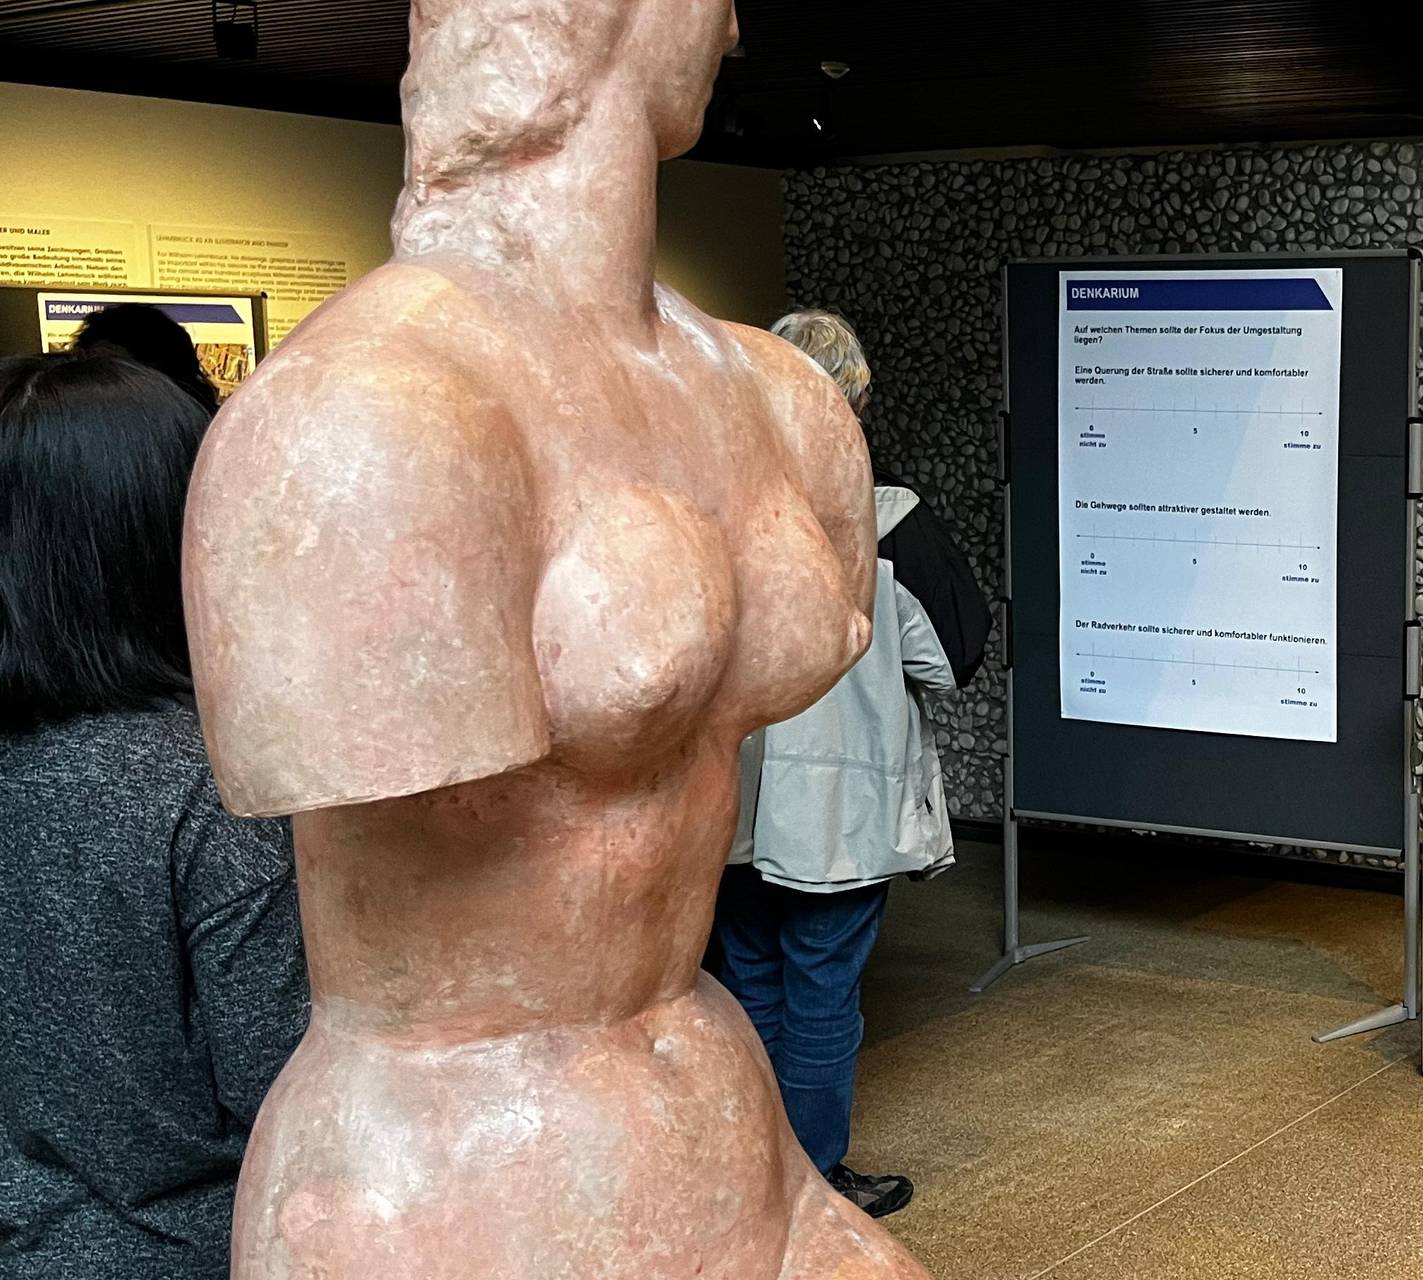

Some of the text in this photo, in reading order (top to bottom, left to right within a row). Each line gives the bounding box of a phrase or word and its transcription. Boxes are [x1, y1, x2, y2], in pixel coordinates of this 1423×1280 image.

[1071, 287, 1140, 299] DENKARIUM
[1074, 326, 1302, 336] Auf welchen Themen sollte der Fokus der Umgestaltung
[1074, 336, 1103, 345] liegen?
[1075, 366, 1309, 377] Eine Querung der Straße sollte sicherer und komfortabler
[1075, 377, 1106, 385] werden.
[1075, 500, 1272, 517] Die Gehwege sollten attraktiver gestaltet werden.
[1075, 620, 1327, 645] Der Radverkehr sollte sicherer und komfortabler funktionieren.
